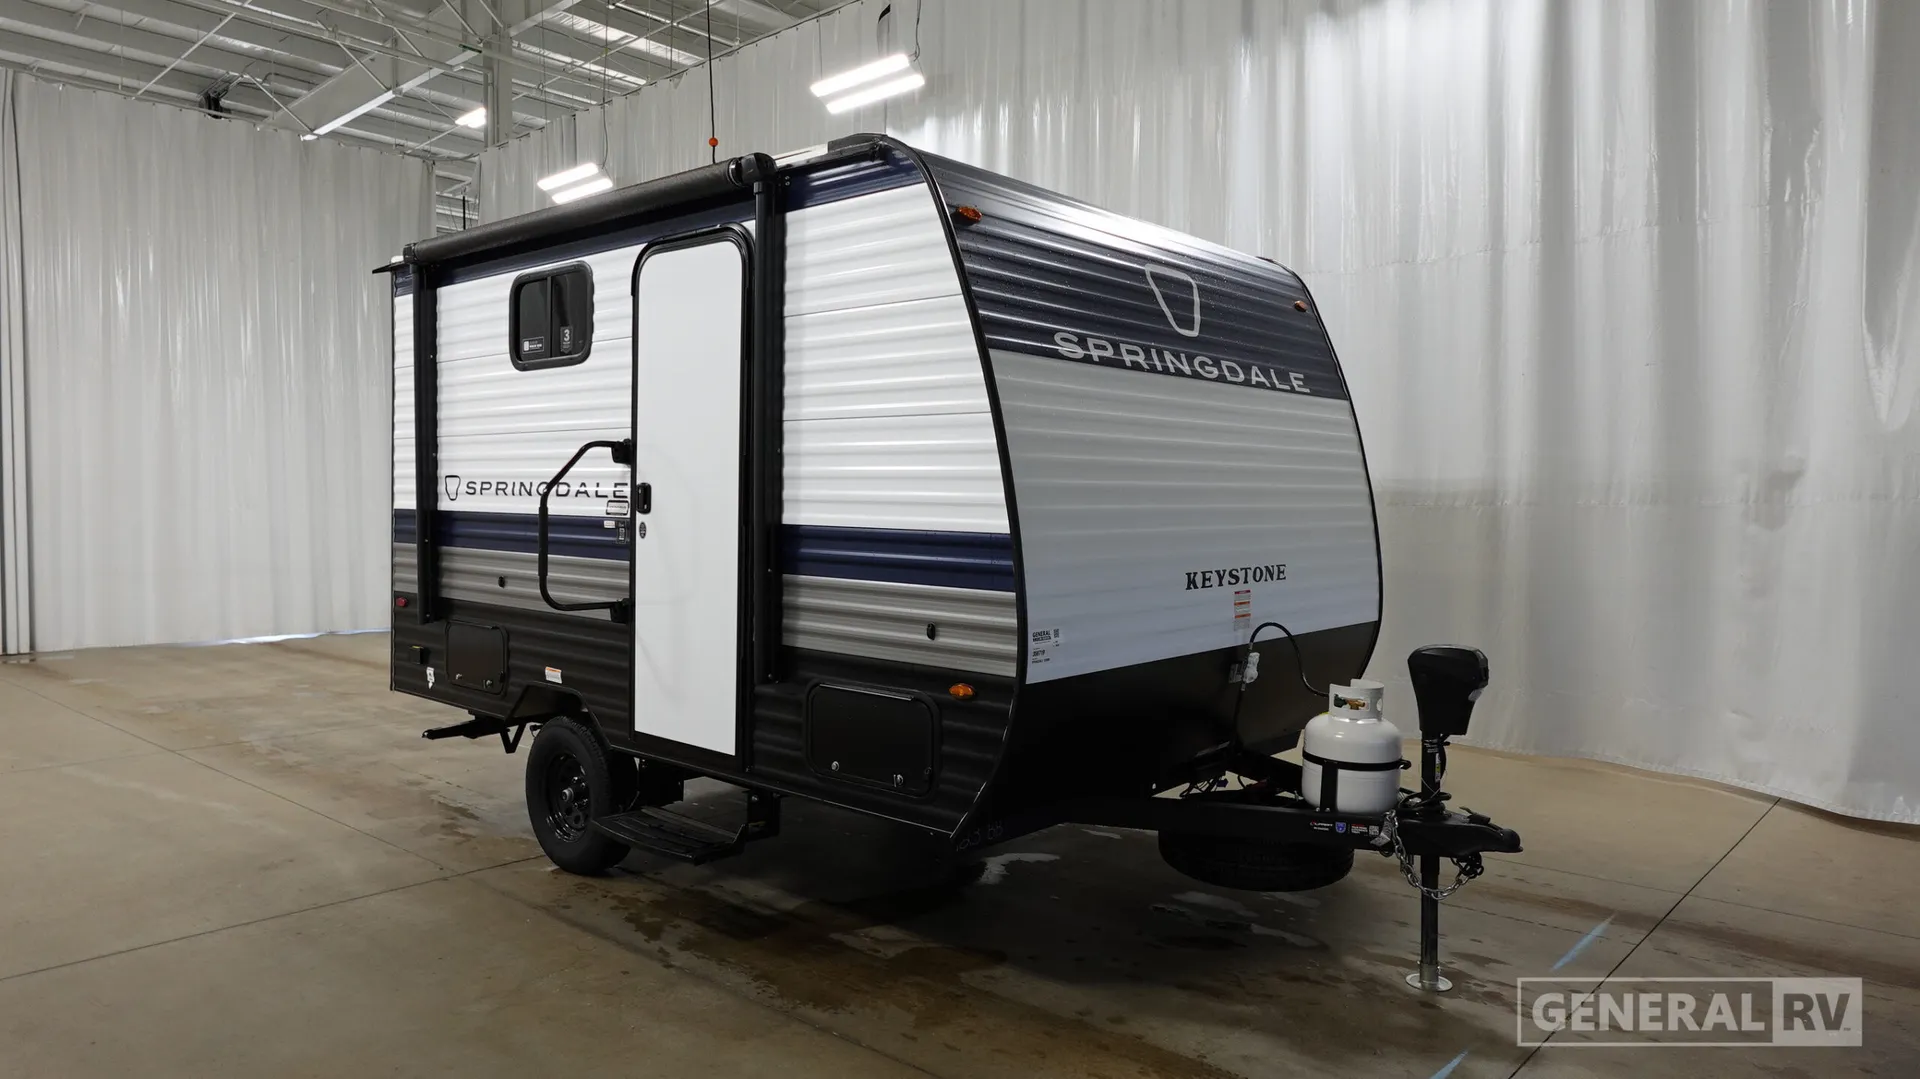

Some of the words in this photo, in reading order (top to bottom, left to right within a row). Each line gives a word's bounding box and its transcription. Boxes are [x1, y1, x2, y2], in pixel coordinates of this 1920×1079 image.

[563, 329, 570, 341] 3
[1053, 332, 1311, 393] SPRINGDALE
[1185, 564, 1287, 590] KEYSTONE
